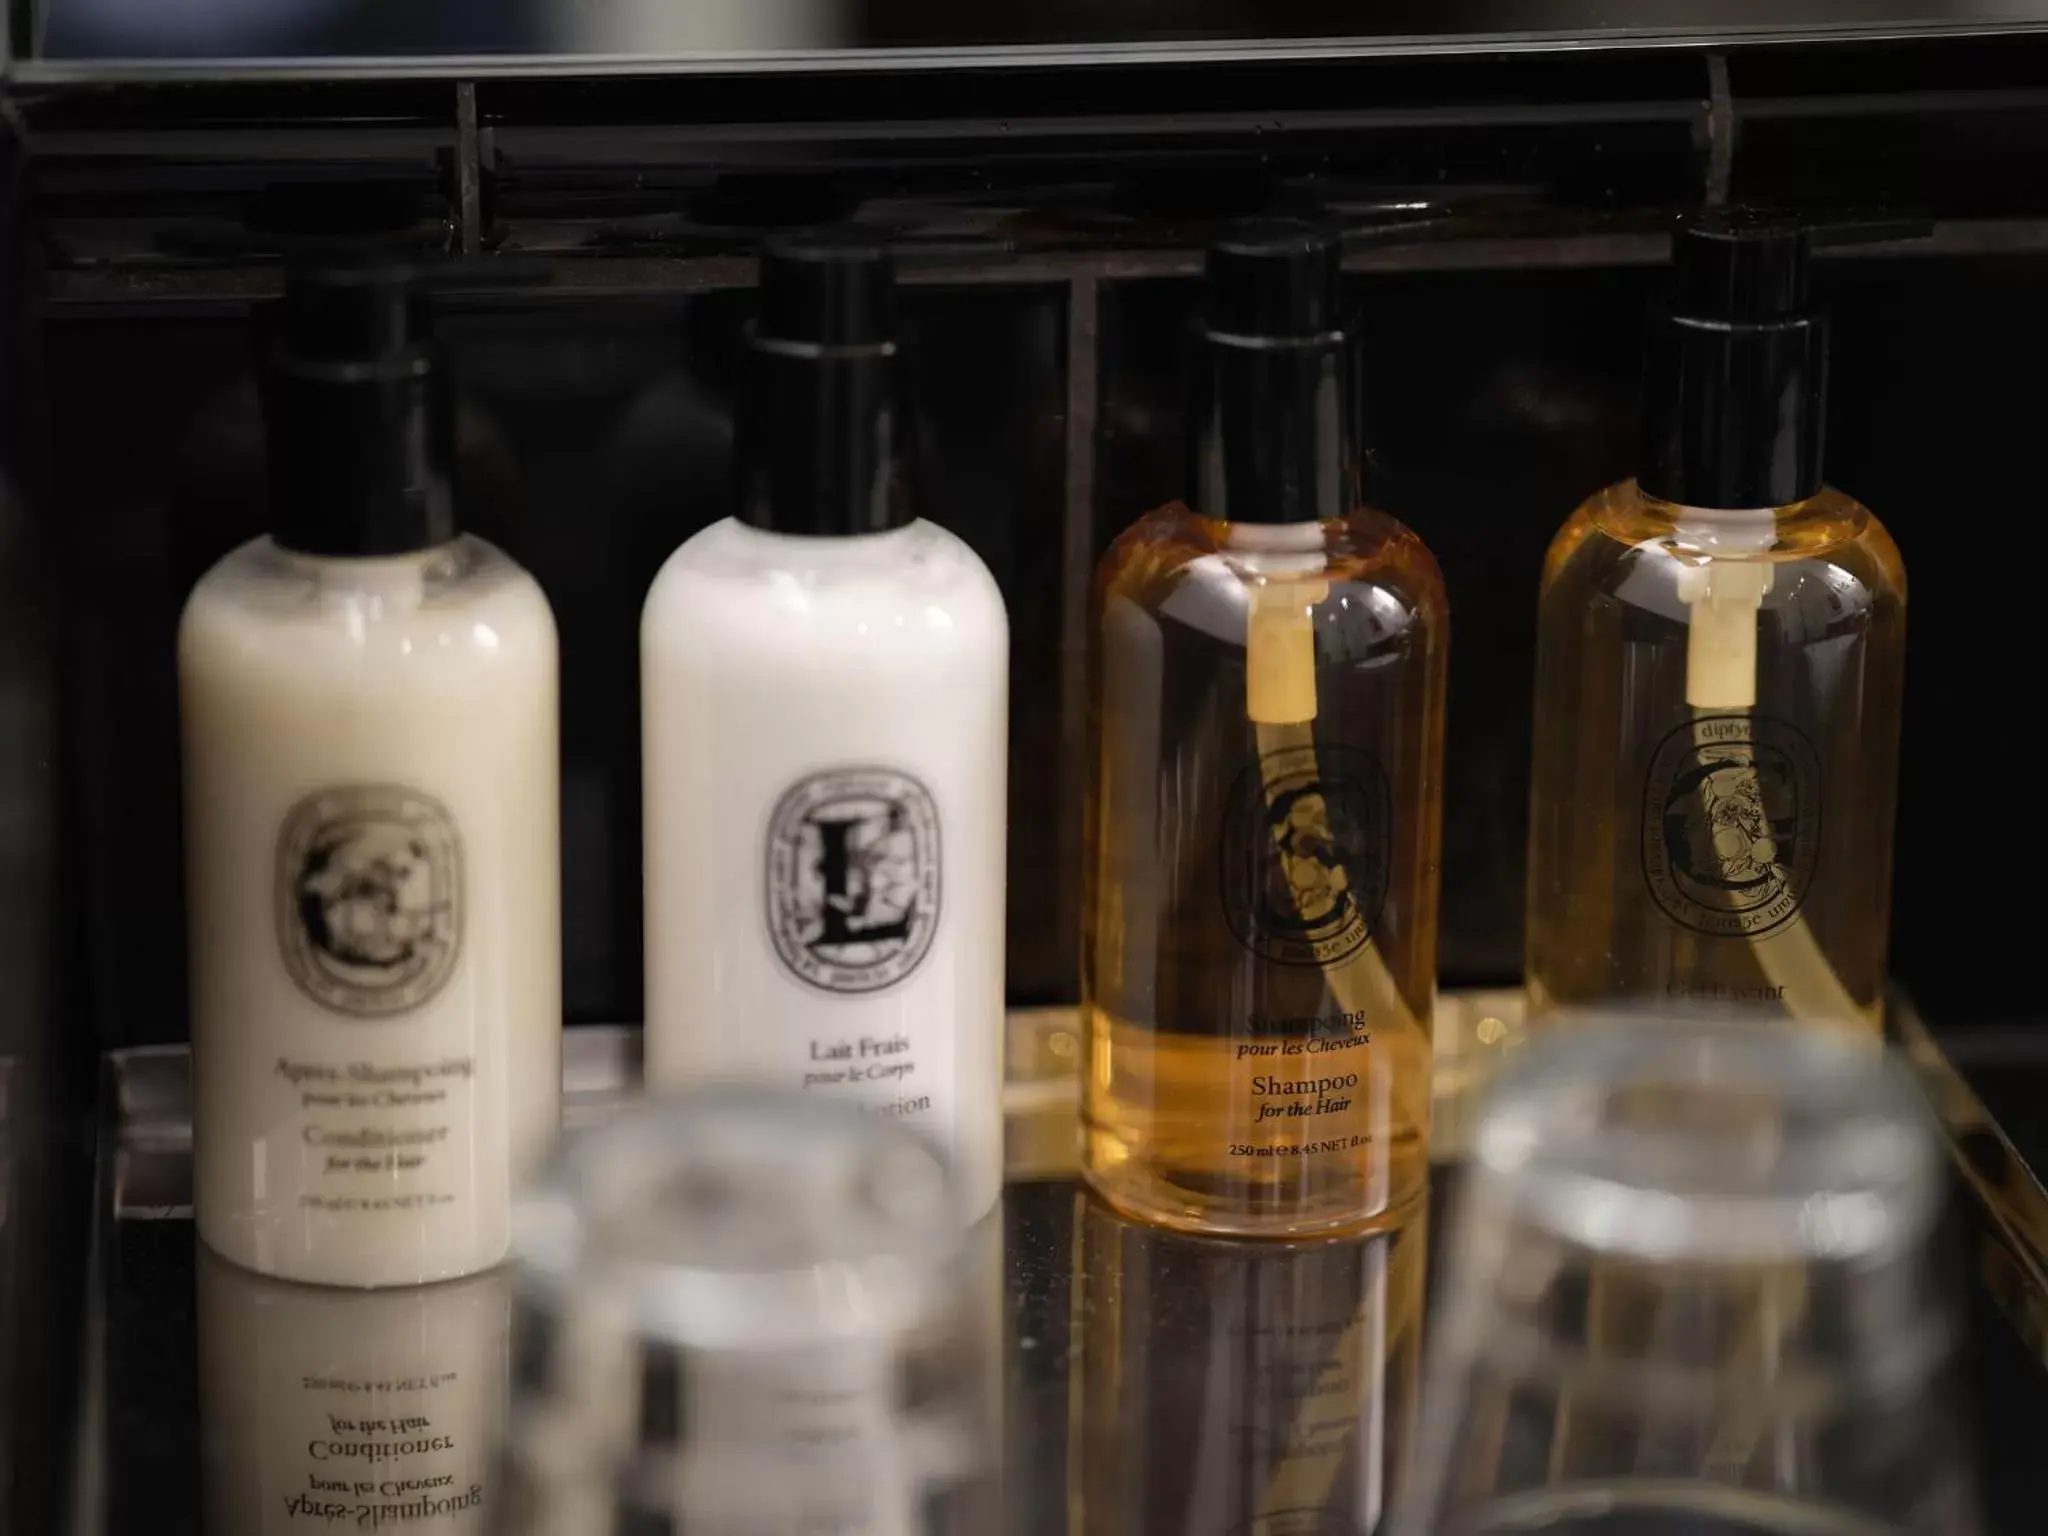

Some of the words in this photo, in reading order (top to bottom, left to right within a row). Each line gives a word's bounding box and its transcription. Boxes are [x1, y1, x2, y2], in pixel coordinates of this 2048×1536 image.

[807, 1039, 853, 1060] Lait
[860, 1033, 910, 1058] Frais
[1236, 1042, 1278, 1059] pour
[1282, 1038, 1303, 1056] les
[1306, 1032, 1371, 1055] Cheveux
[866, 1060, 915, 1080] Corps
[1251, 1072, 1358, 1099] Shampoo
[1255, 1102, 1284, 1122] for
[1287, 1101, 1313, 1117] the
[1315, 1096, 1352, 1115] Hair
[1229, 1144, 1254, 1156] 250
[1320, 1135, 1347, 1152] NET
